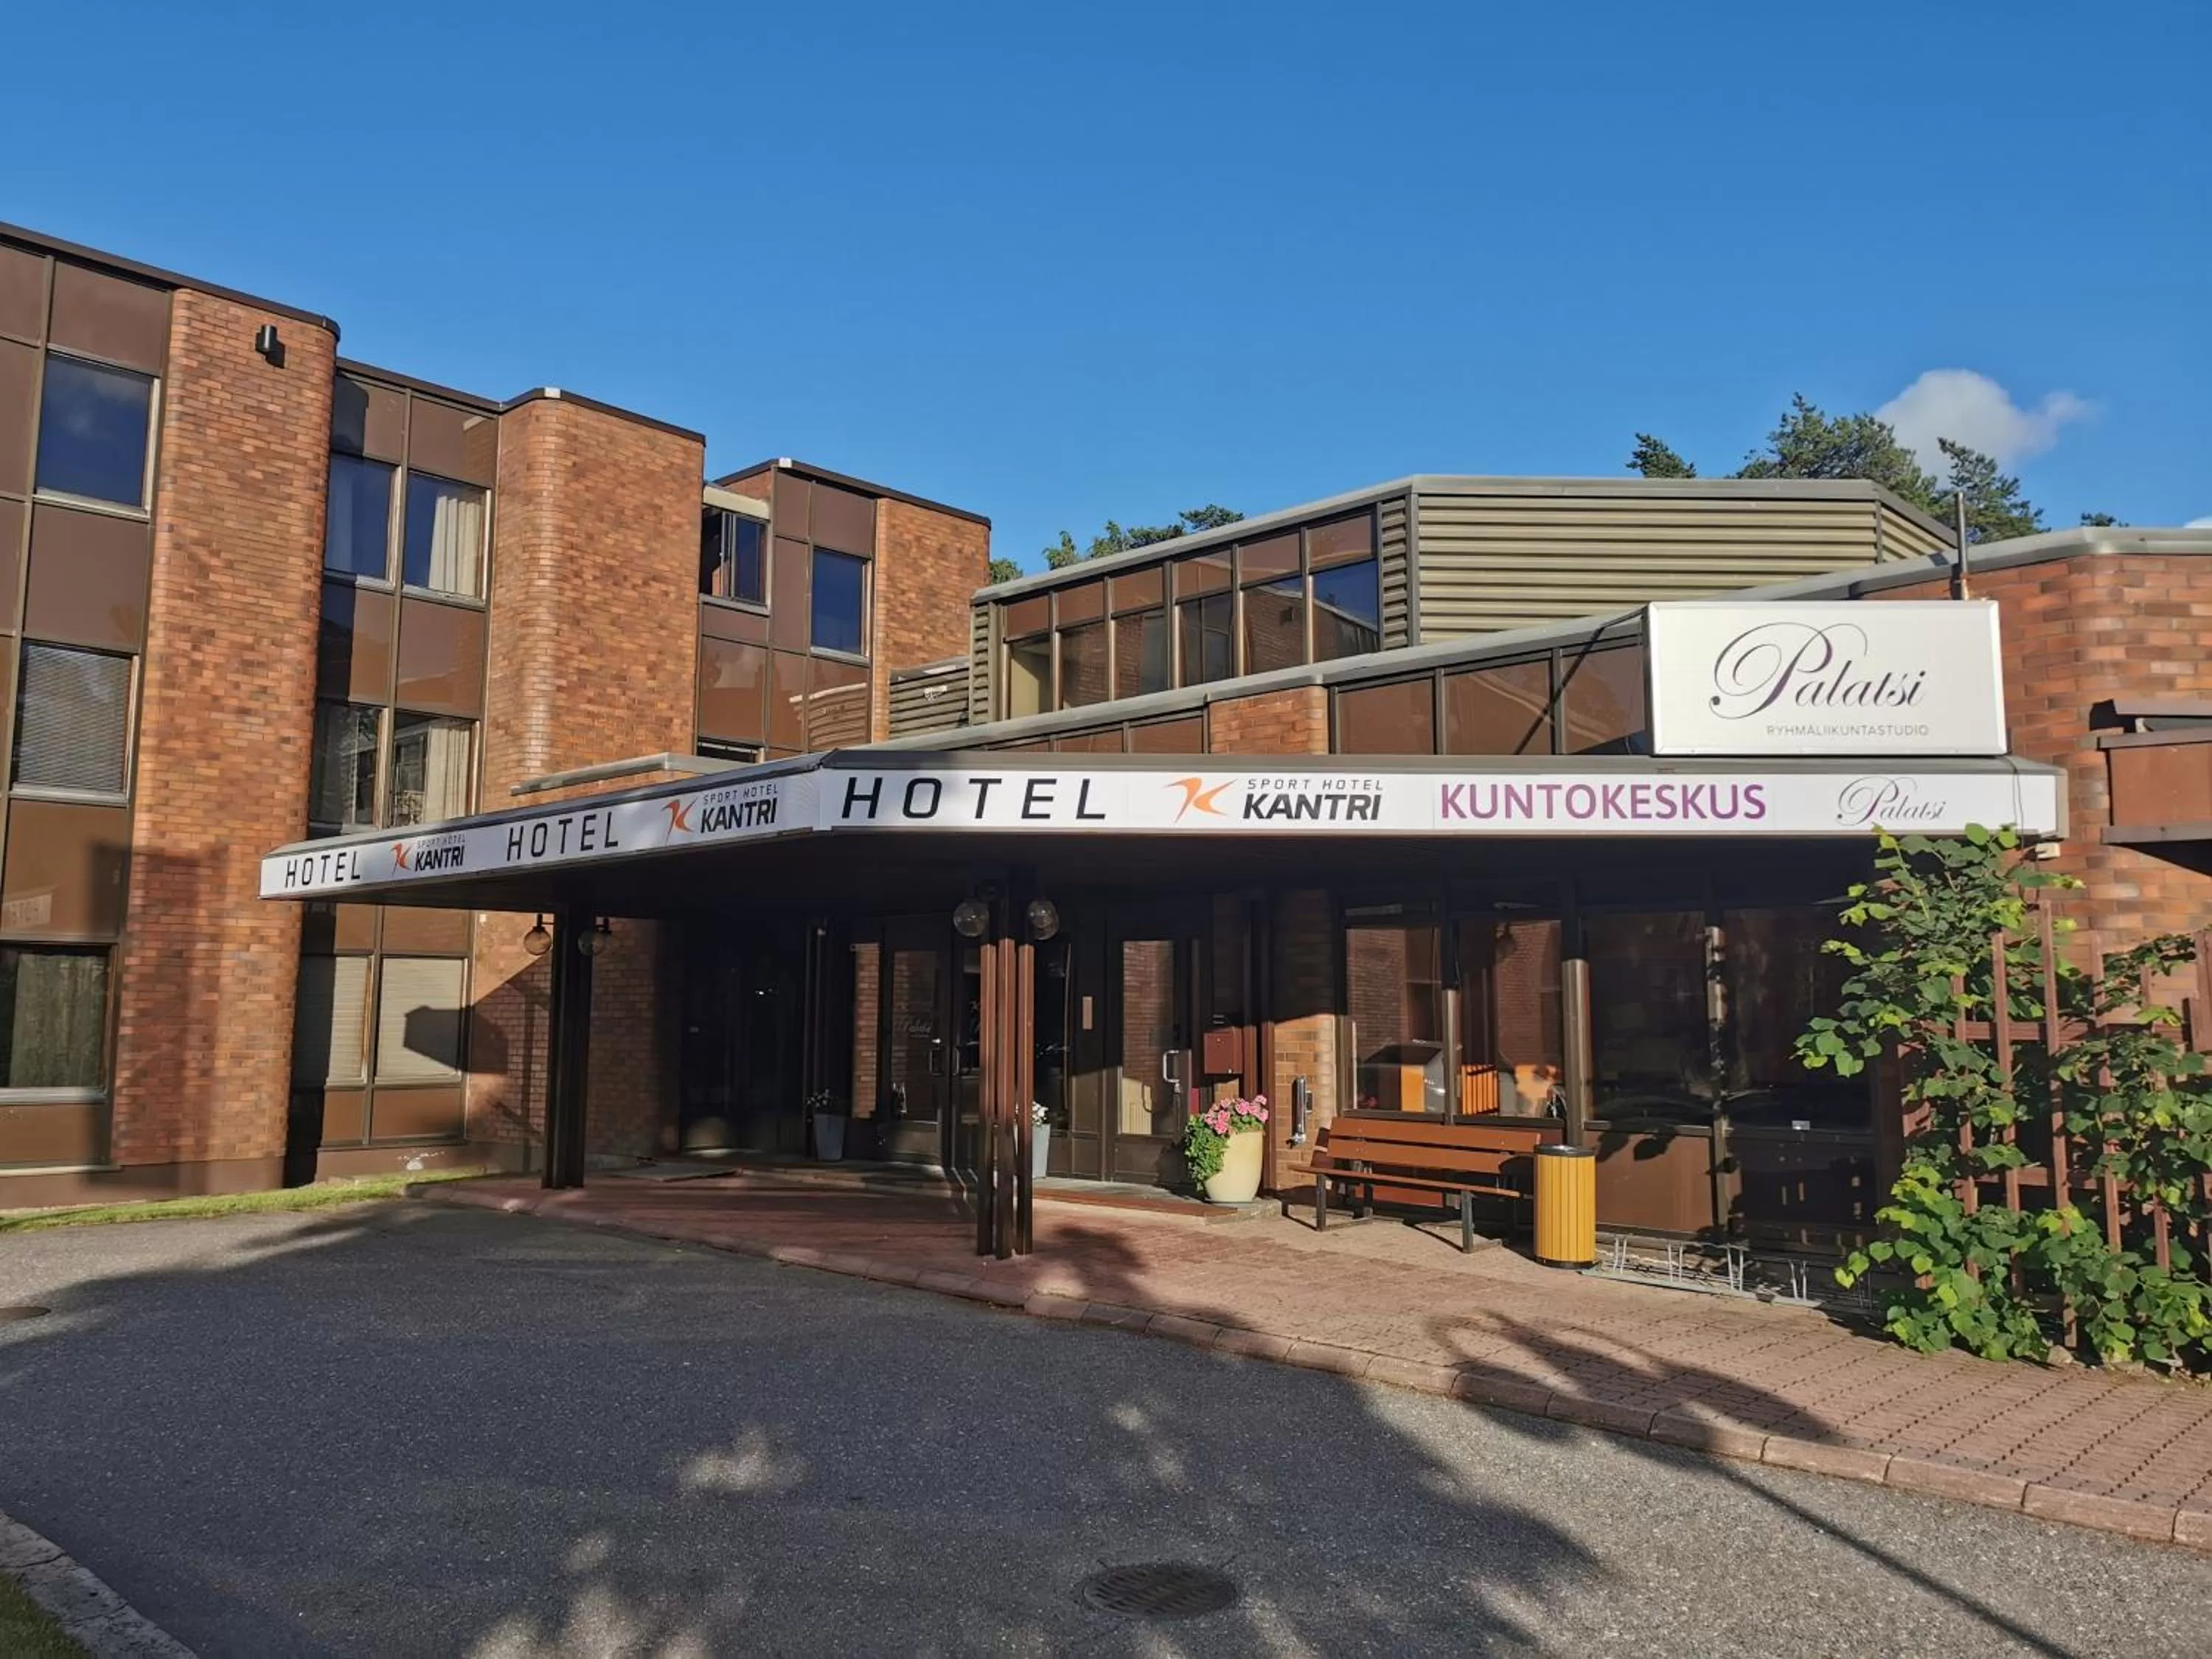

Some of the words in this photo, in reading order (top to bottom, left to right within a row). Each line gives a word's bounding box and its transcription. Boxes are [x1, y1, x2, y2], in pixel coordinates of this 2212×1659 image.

[1709, 622, 1926, 720] Palatsi
[703, 790, 737, 805] SPORT
[742, 784, 778, 799] HOTEL
[841, 776, 1106, 819] HOTEL
[1247, 779, 1310, 790] SPORT
[1322, 779, 1383, 791] HOTEL
[1441, 784, 1767, 820] KUNTOKESKUS
[1836, 776, 1947, 827] Palatsi
[700, 798, 778, 834] KANTRI
[1242, 793, 1382, 821] KANTRI
[507, 812, 618, 862] HOTEL
[285, 851, 361, 888] HOTEL
[414, 845, 465, 872] KANTRI
